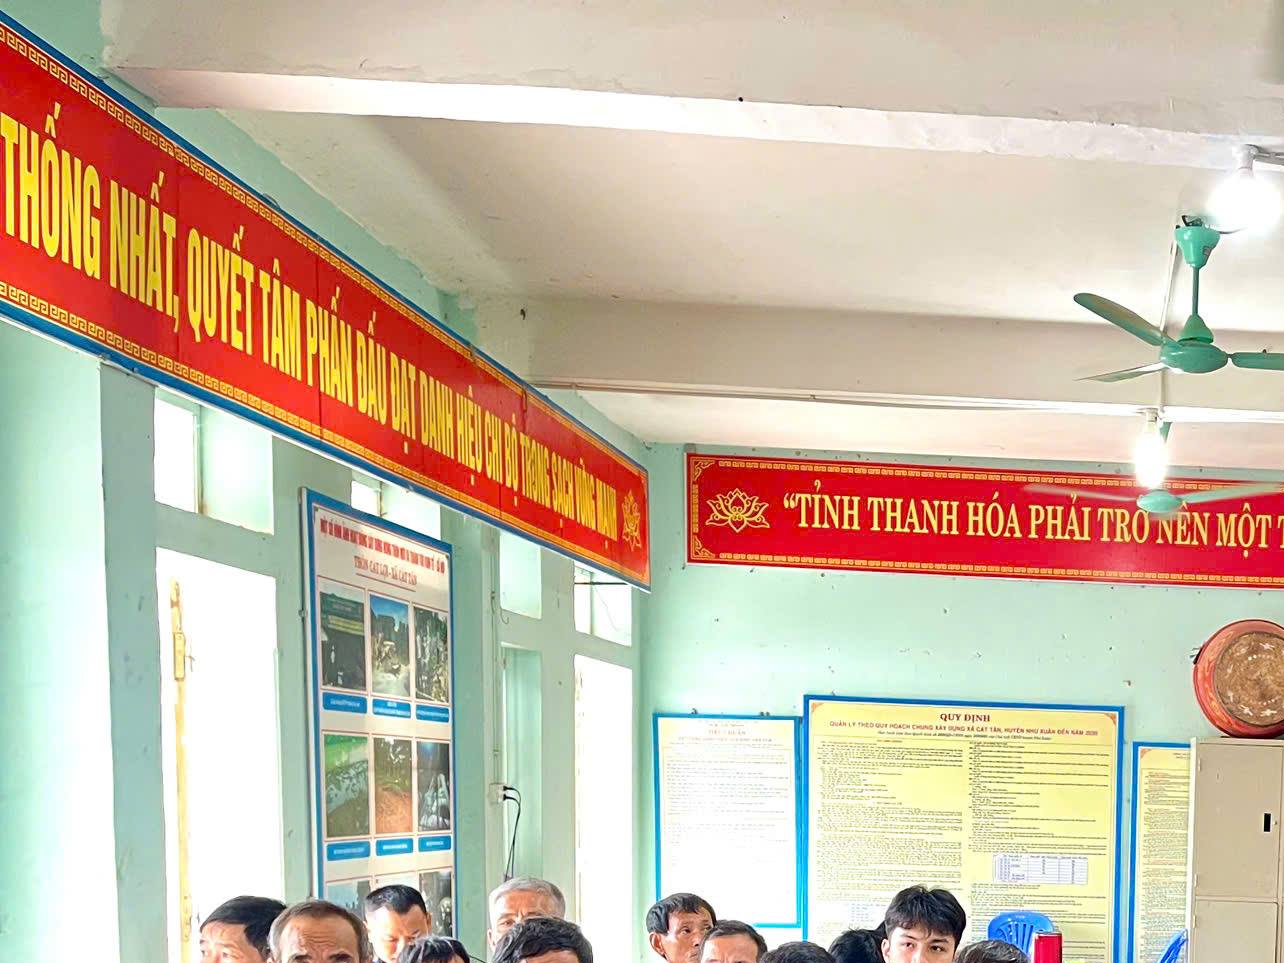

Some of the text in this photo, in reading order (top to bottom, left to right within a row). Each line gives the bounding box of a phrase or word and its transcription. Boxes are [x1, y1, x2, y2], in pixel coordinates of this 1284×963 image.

[0, 102, 101, 280] THỐNG
[110, 171, 179, 333] NHẤT,
[187, 225, 254, 356] QUYẾT
[259, 258, 302, 381] TÂM
[306, 286, 354, 407] PHẤN
[356, 310, 387, 425] ĐẤU
[390, 351, 416, 455] ĐẠT
[419, 369, 455, 460] DANH
[456, 384, 483, 486] HIỆU
[484, 410, 503, 484] CHI
[504, 412, 519, 507] BỘ
[520, 432, 551, 509] TRONG
[552, 452, 575, 528] SẠCH
[867, 496, 959, 534] THANH
[966, 491, 1022, 538] HÓA
[1028, 491, 1091, 541] PHẢI
[1156, 501, 1210, 546] NÊN
[1216, 502, 1272, 558] MỘT
[940, 713, 990, 723] QUY ĐỊNH
